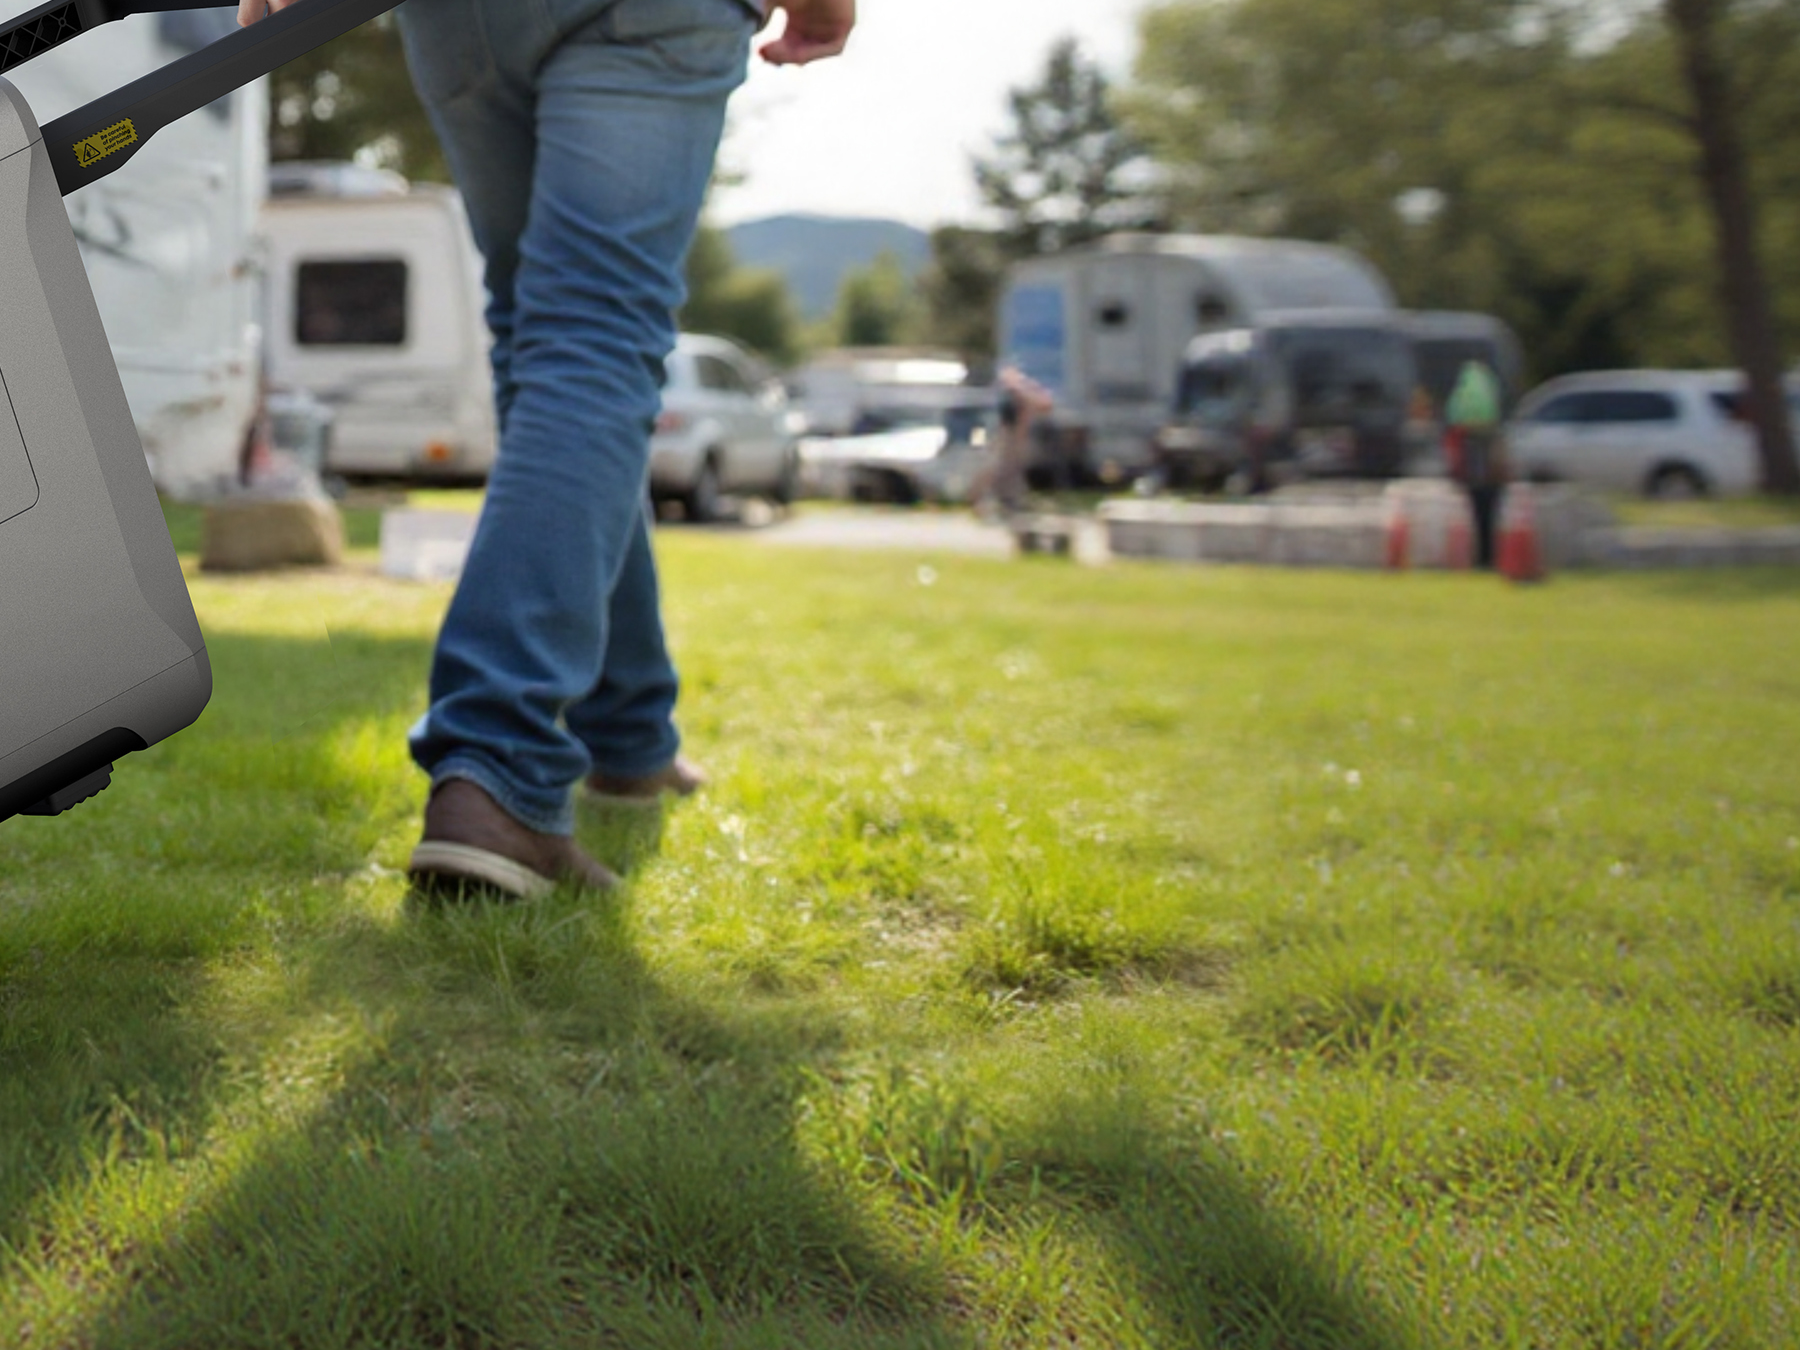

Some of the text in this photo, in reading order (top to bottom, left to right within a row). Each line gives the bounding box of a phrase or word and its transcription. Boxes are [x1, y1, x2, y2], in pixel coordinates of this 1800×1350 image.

[108, 124, 126, 136] careful
[109, 129, 130, 142] pinching
[105, 134, 132, 151] your hands
